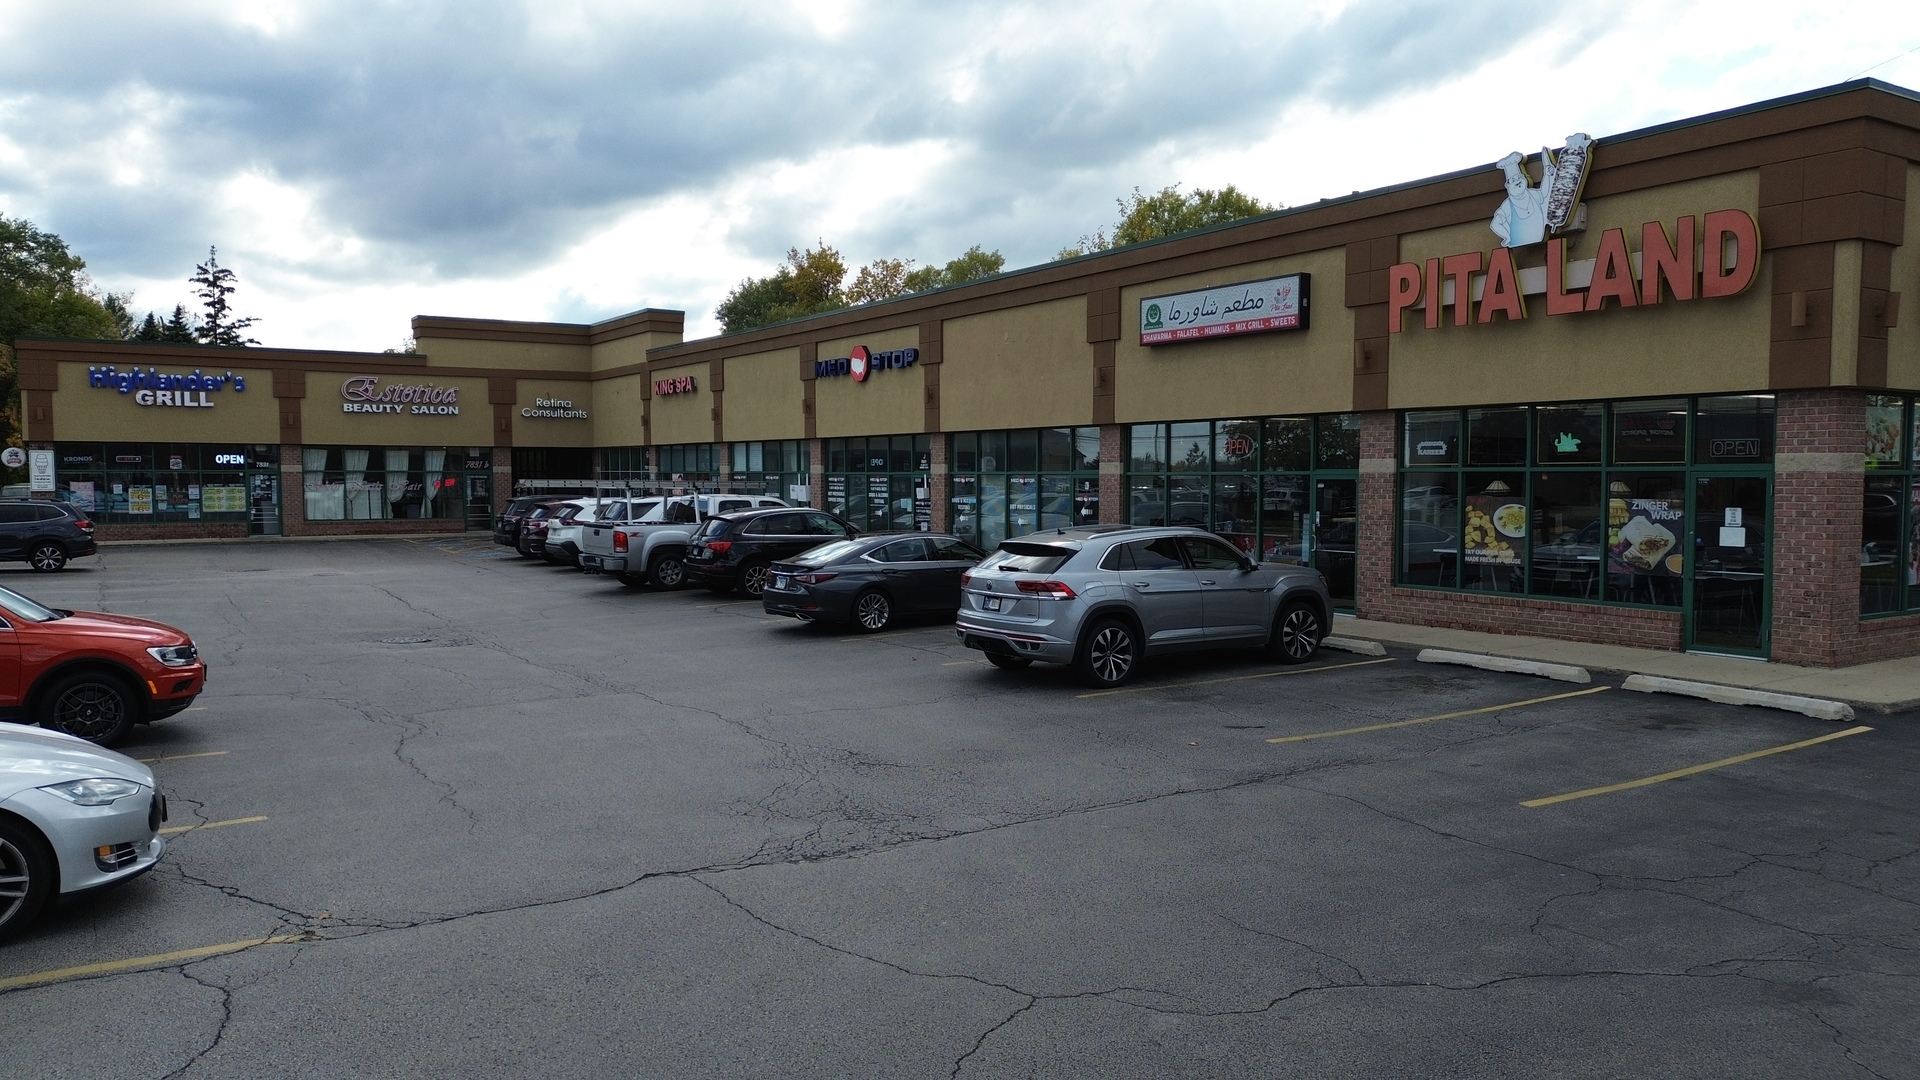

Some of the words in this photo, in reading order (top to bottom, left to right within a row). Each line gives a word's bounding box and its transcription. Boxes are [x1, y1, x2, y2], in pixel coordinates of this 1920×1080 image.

[1388, 247, 1525, 333] PITA
[1546, 208, 1761, 317] LAND
[1221, 288, 1265, 320] مطعم
[1143, 331, 1172, 343] SHAWARMA
[1177, 328, 1200, 339] FALAFEL
[1204, 324, 1230, 335] HUMMUS
[1235, 322, 1247, 331] MIX
[1247, 320, 1265, 330] GRILL
[1270, 316, 1296, 327] SWEETS
[815, 358, 849, 377] MED
[871, 348, 918, 371] STOP
[89, 365, 246, 395] Highlander's
[654, 378, 674, 396] KING
[675, 375, 693, 393] SPA
[341, 375, 460, 404] Estetica
[135, 390, 215, 408] GRILL
[536, 398, 572, 408] Retina
[343, 403, 404, 414] BEAUTY
[411, 404, 460, 415] SALON
[521, 407, 588, 419] Consultants
[1224, 439, 1250, 455] OPEN
[1712, 441, 1758, 455] OPEN
[215, 454, 245, 464] OPEN
[465, 460, 482, 469] 7831
[1631, 501, 1669, 511] ZINGER
[1650, 510, 1682, 520] WRAP
